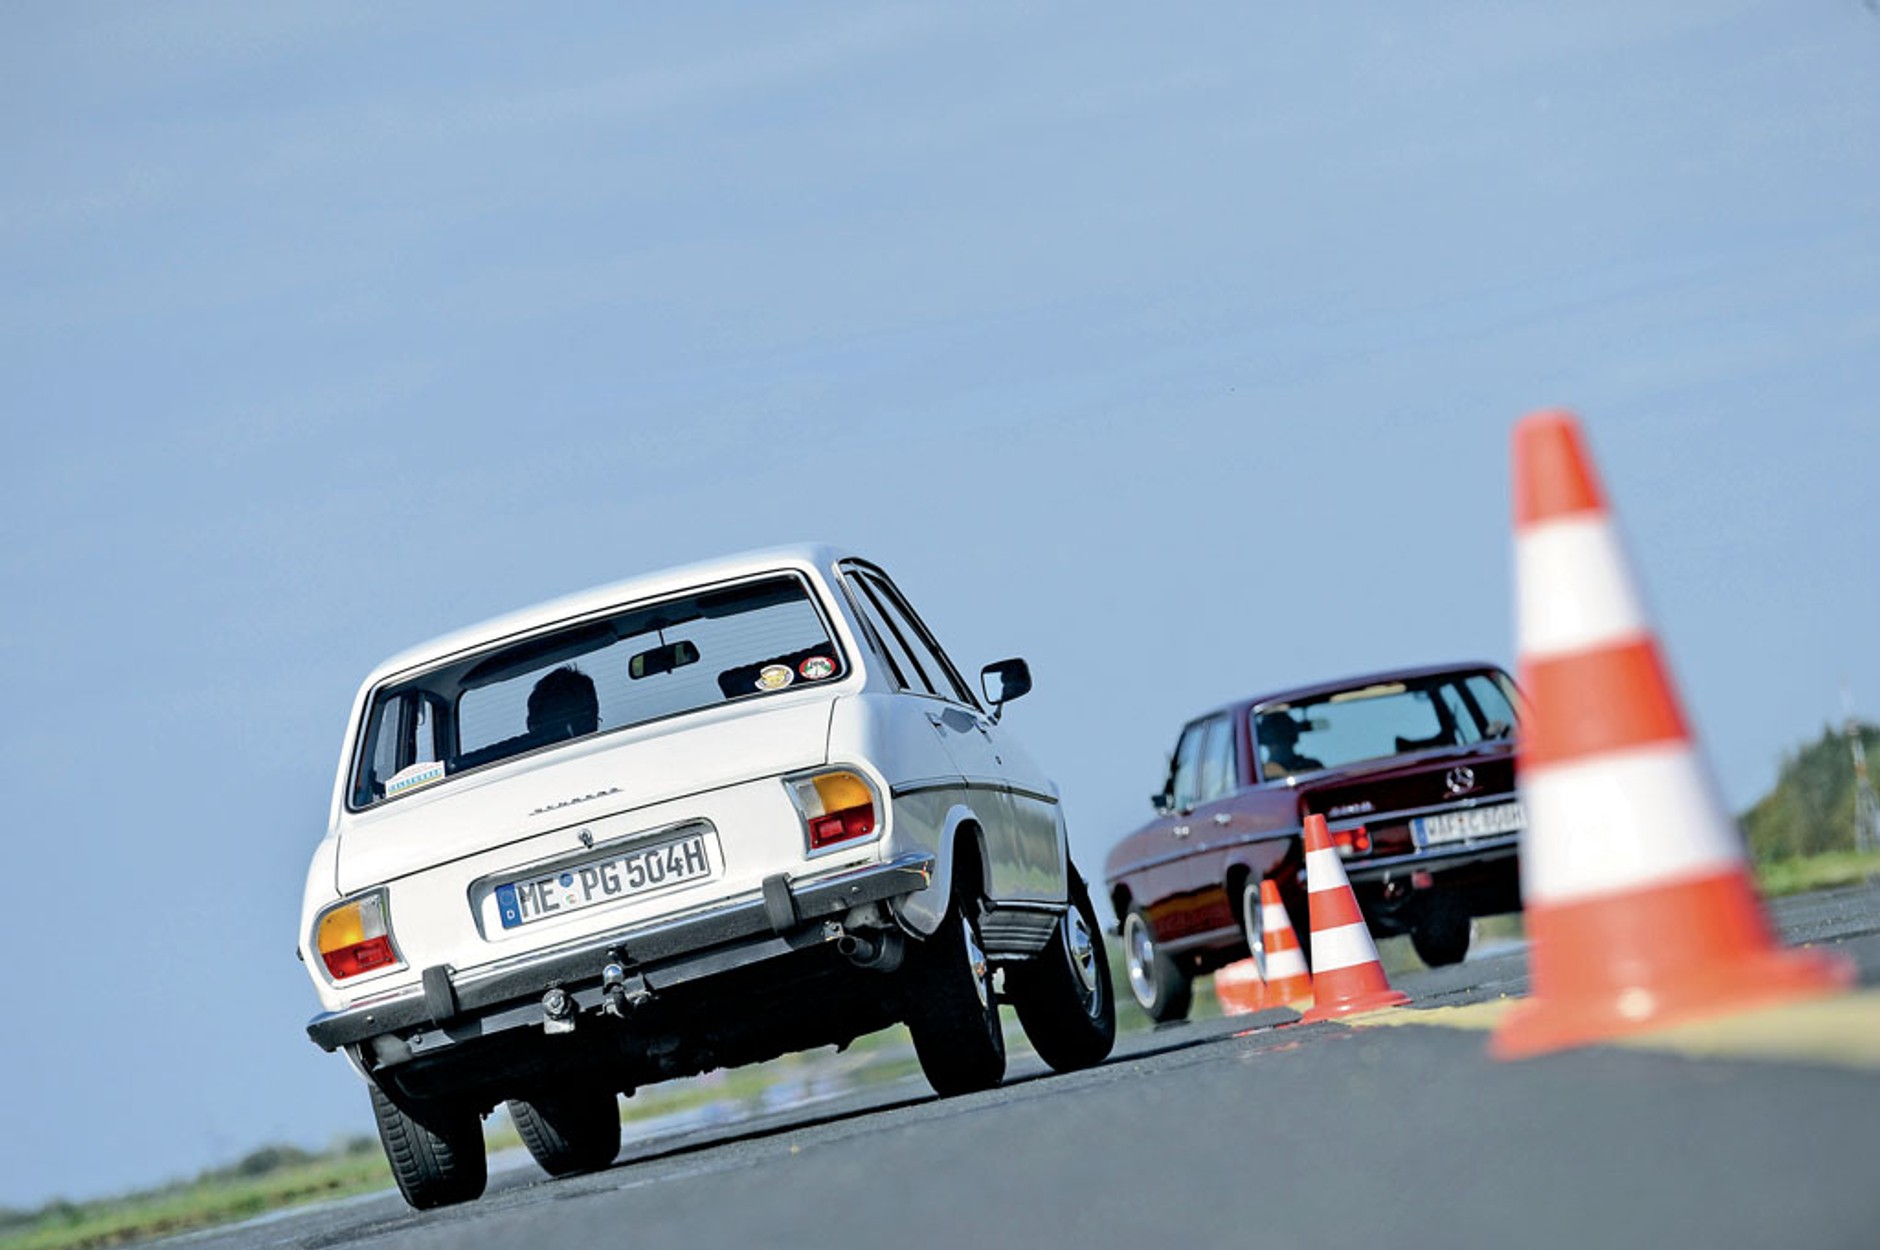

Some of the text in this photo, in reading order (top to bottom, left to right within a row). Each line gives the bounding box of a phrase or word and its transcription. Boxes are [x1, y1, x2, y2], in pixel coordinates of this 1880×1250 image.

[516, 839, 706, 918] ME PG 504H
